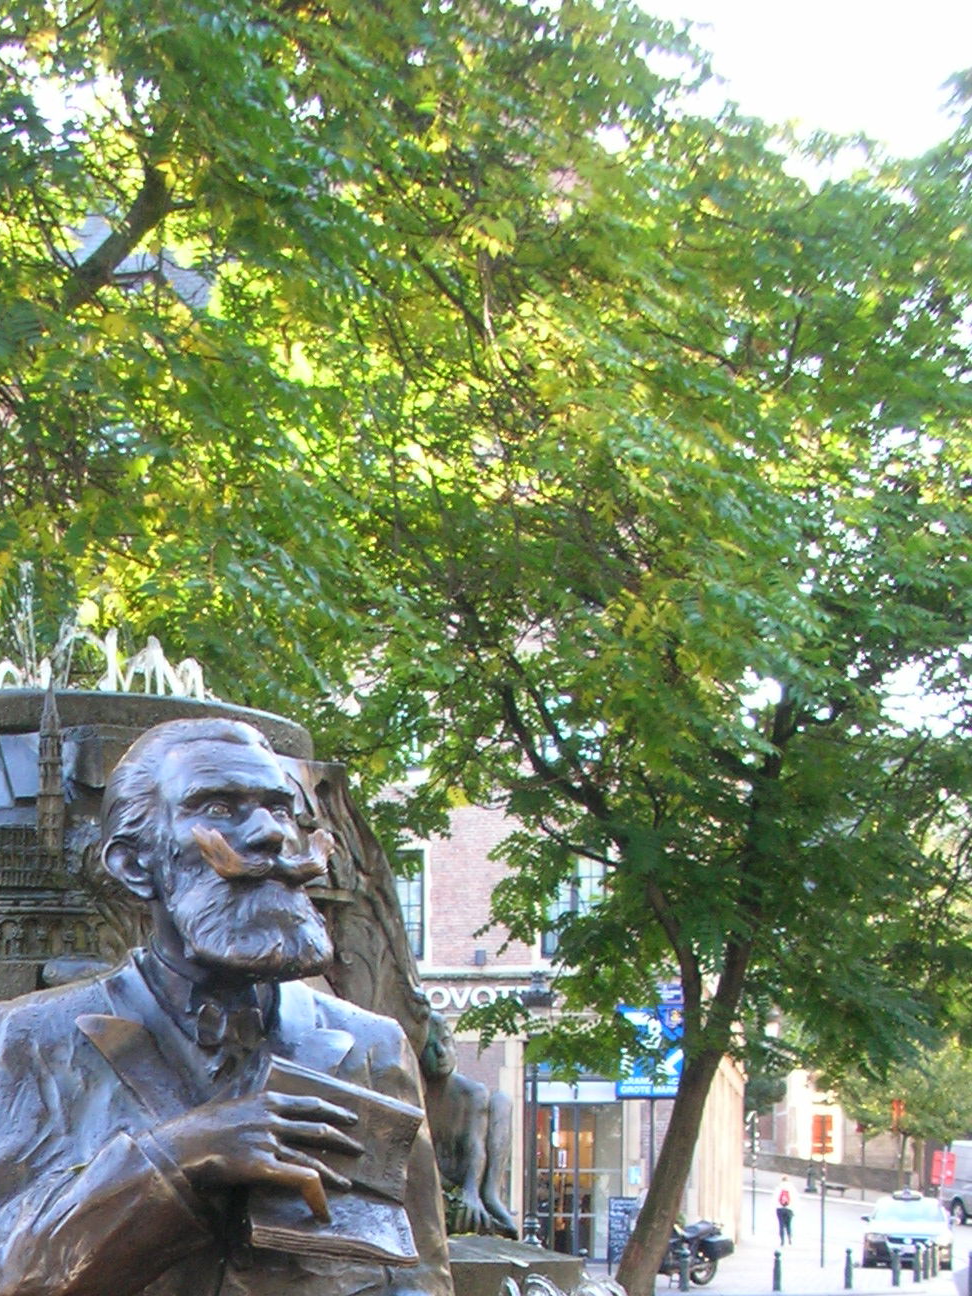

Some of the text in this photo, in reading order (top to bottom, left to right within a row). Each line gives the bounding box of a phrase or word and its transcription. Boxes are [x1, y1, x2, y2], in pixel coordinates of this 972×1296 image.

[424, 986, 558, 1010] OVOT
[620, 1085, 678, 1095] GROTE MARK
